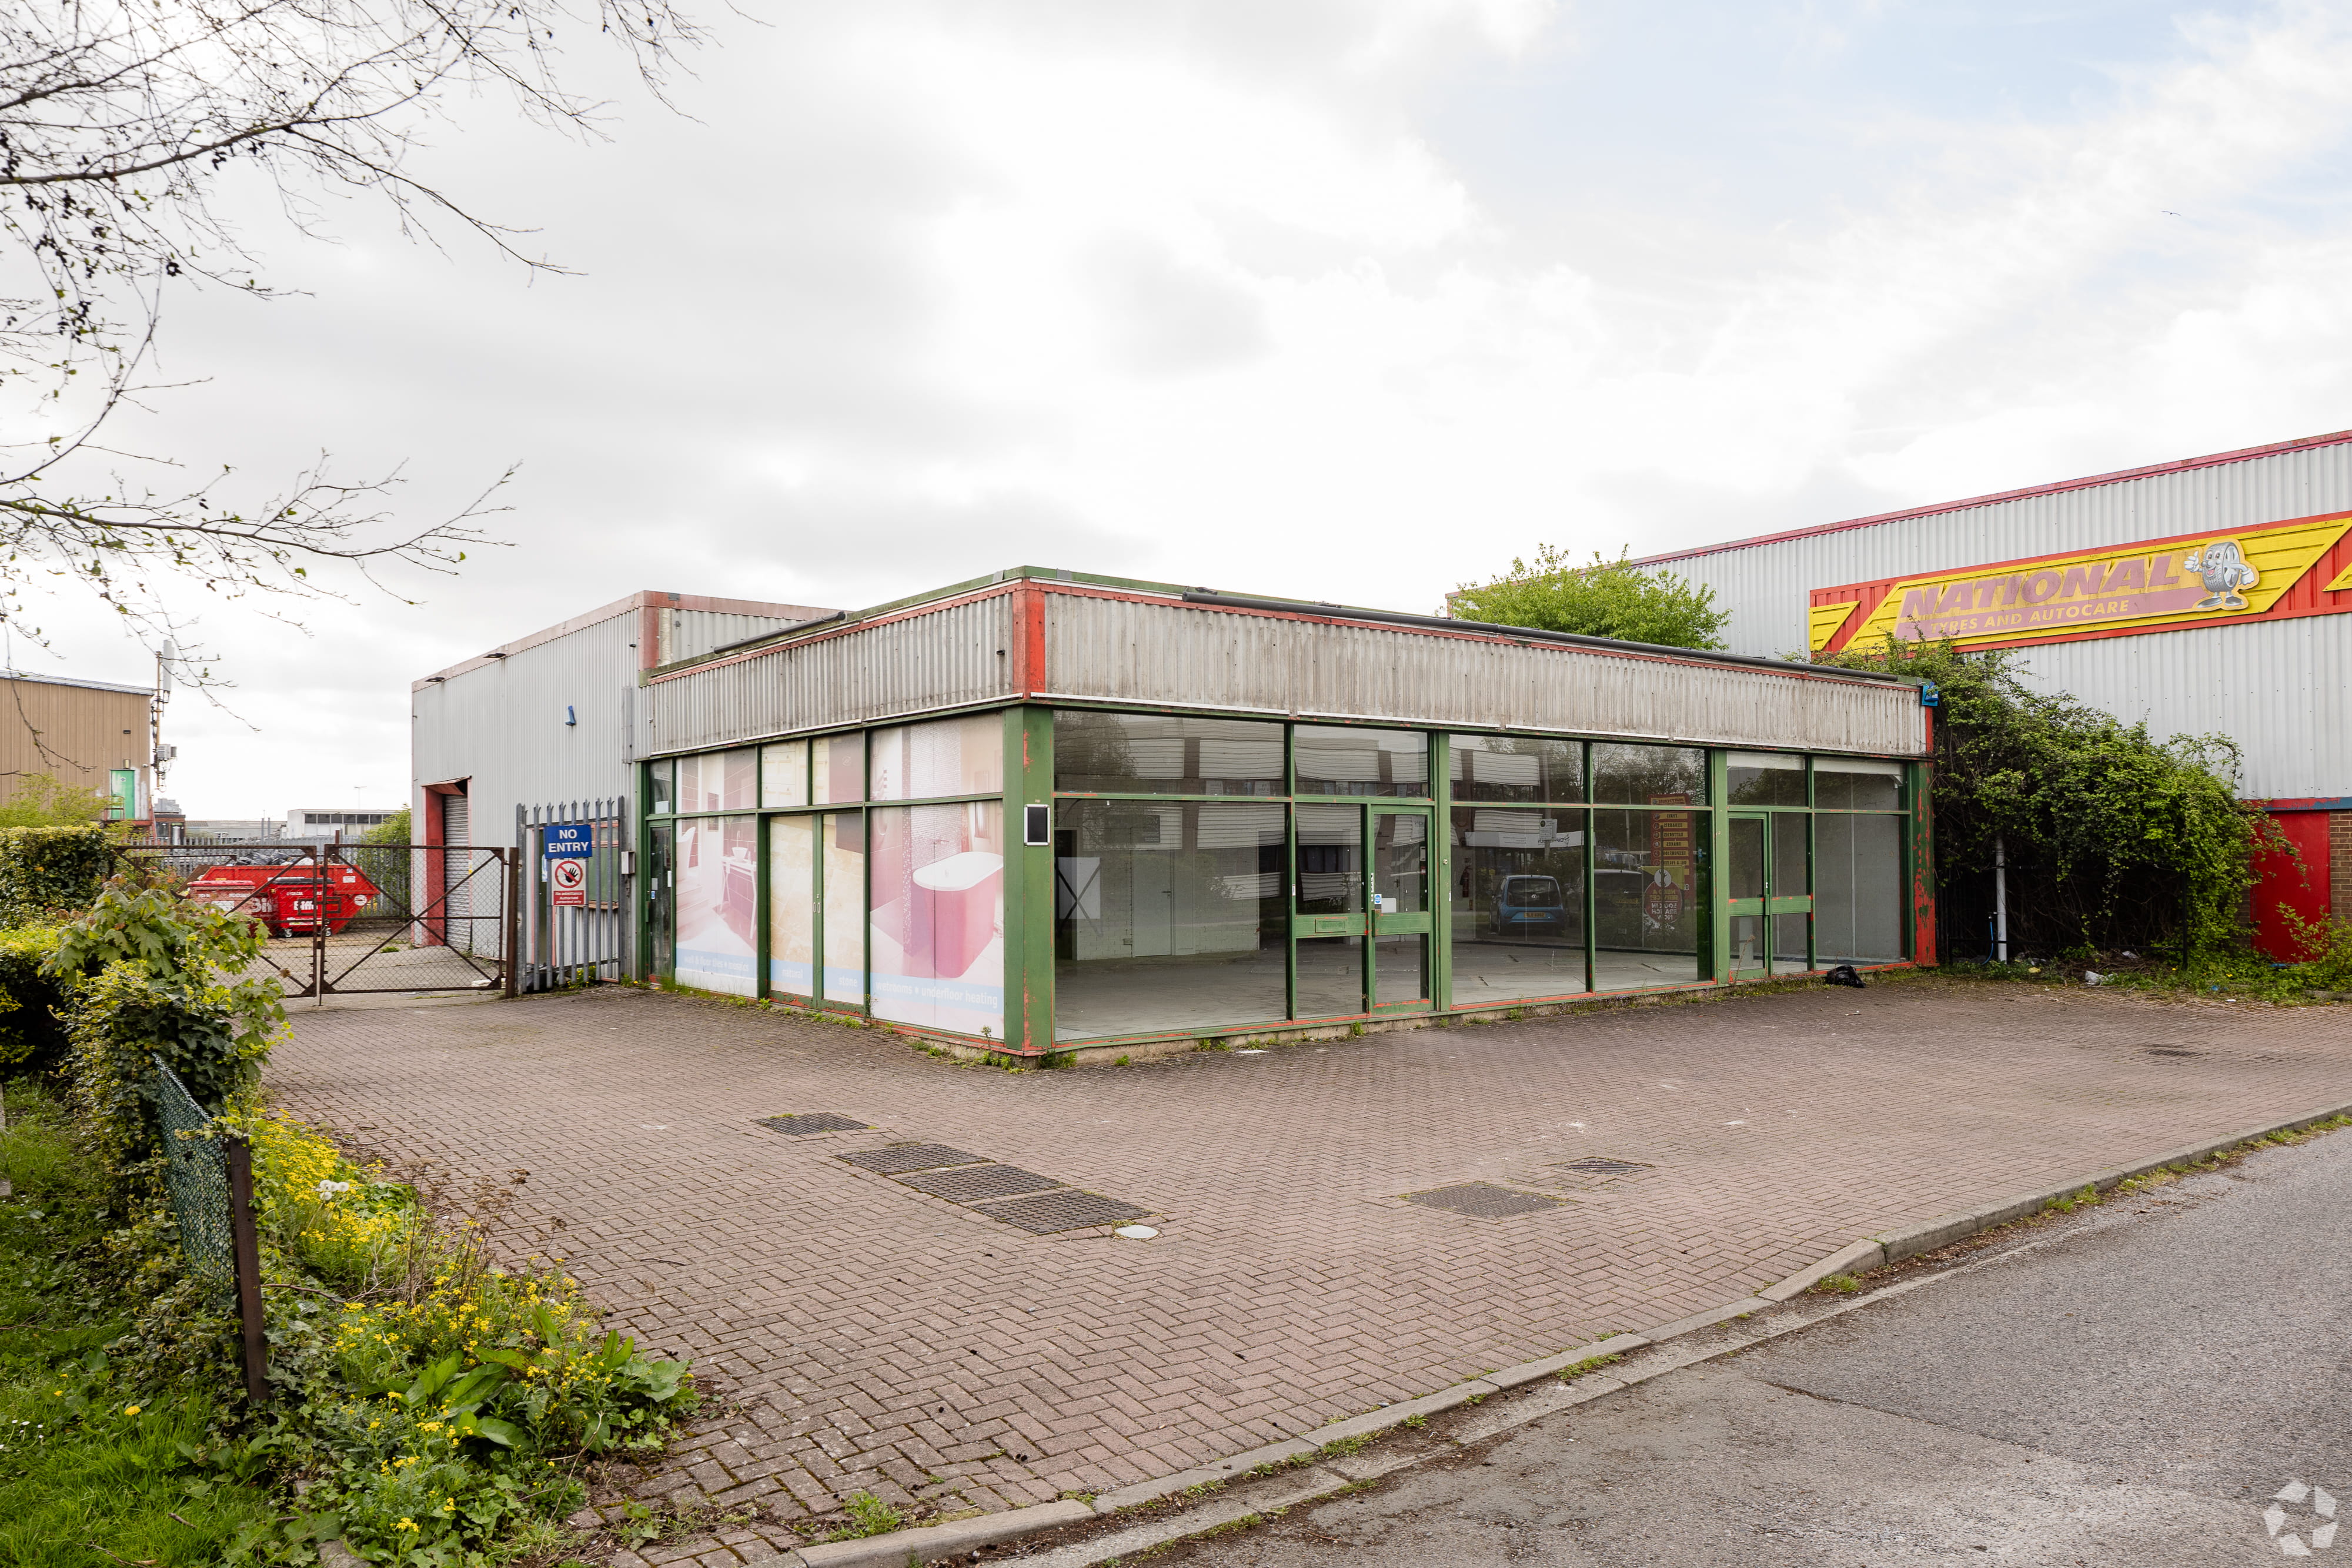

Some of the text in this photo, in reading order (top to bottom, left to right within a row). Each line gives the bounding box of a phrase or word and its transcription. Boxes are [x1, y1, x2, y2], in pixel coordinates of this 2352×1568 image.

[1900, 555, 2180, 617] NATIONAL
[1931, 600, 2129, 634] TYRES AND AUTOCARE
[559, 829, 577, 839] NO
[548, 842, 589, 852] ENTRY
[782, 968, 803, 979] natural
[839, 976, 858, 987] stone
[876, 981, 998, 1008] wetrooms underfloor heating
